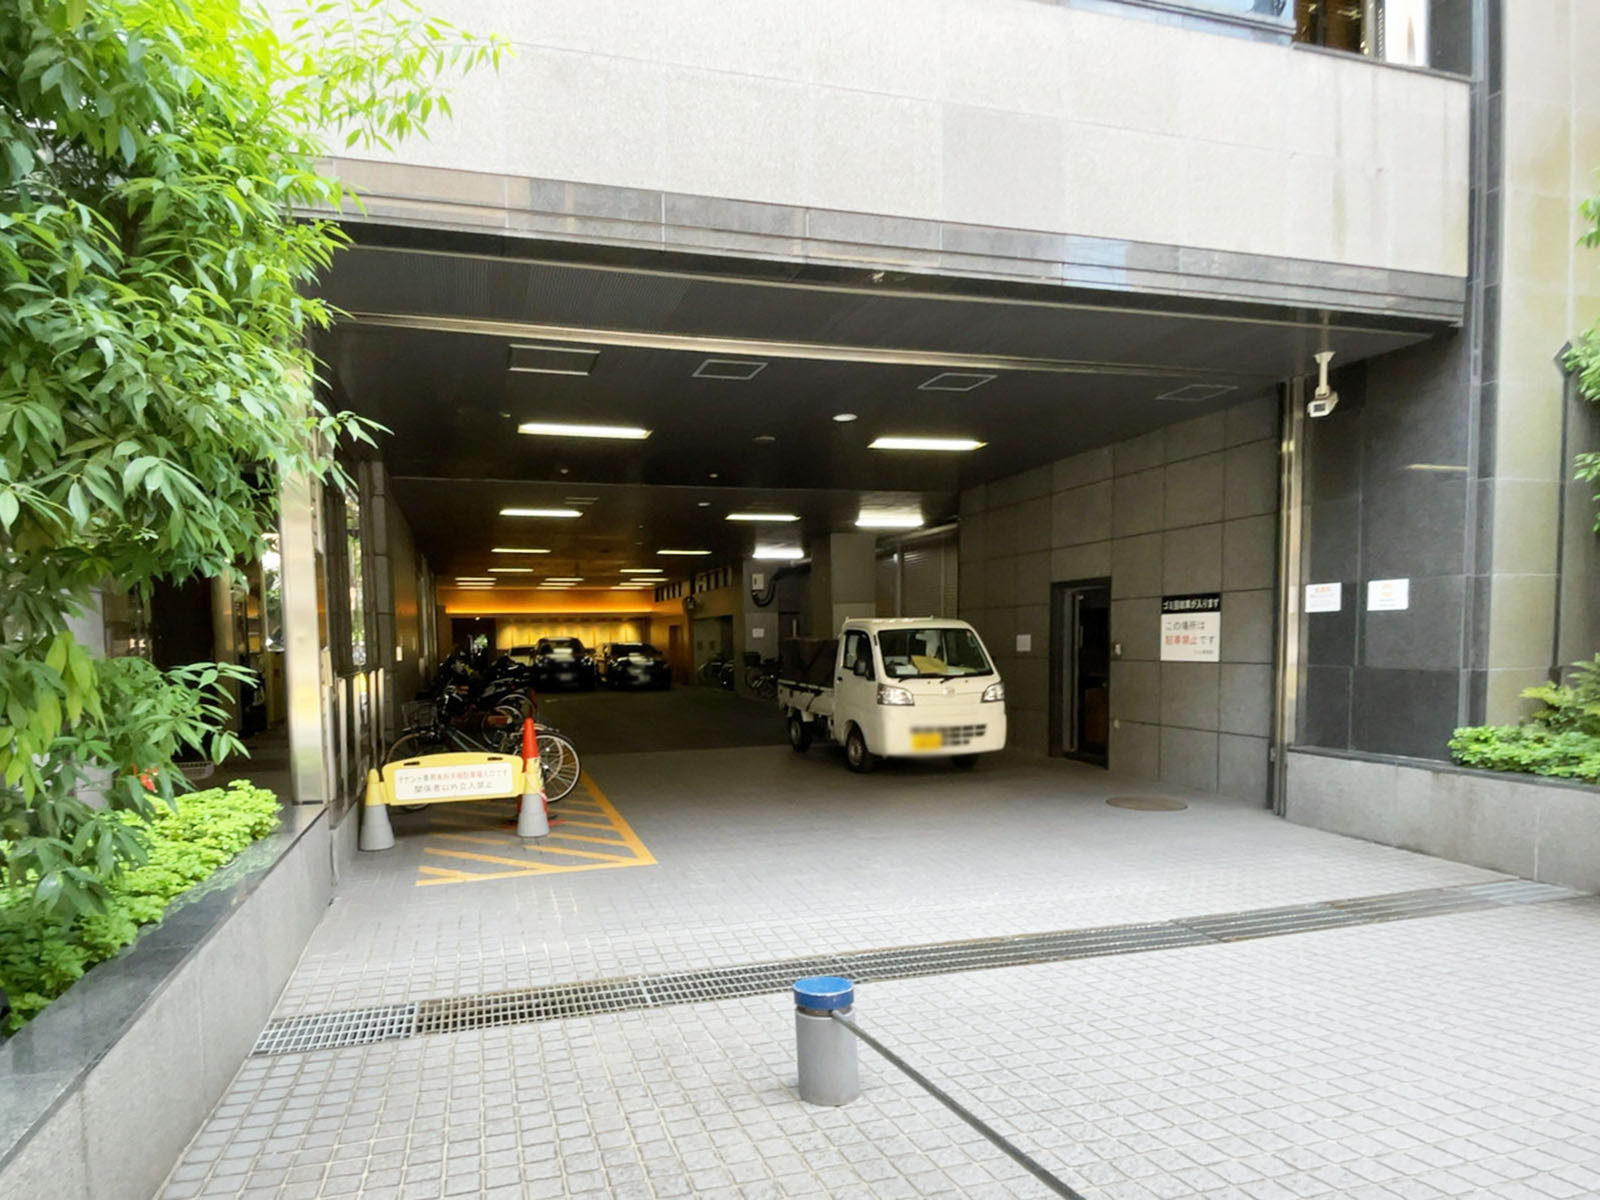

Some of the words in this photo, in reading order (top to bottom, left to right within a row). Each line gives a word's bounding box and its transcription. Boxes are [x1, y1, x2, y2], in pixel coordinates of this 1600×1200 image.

[1165, 620, 1205, 631] この場所は
